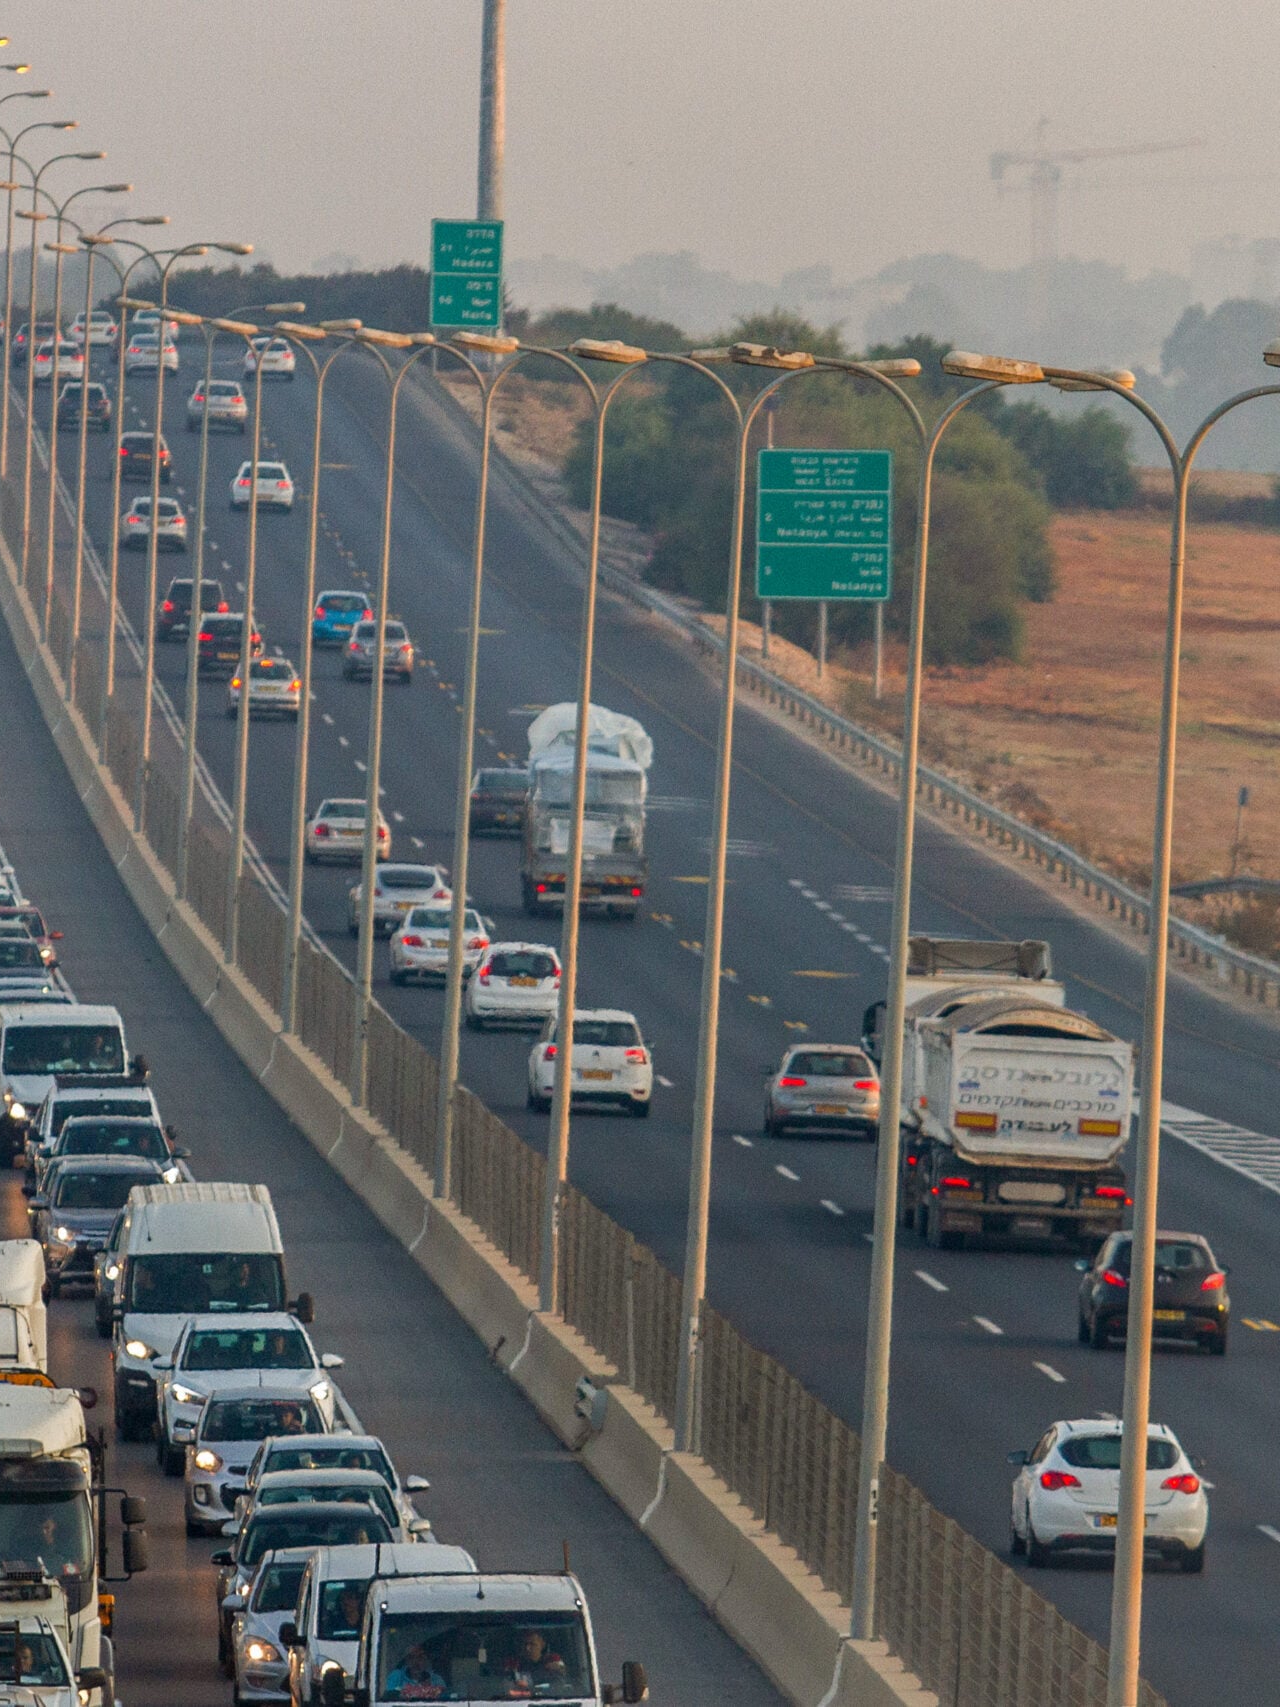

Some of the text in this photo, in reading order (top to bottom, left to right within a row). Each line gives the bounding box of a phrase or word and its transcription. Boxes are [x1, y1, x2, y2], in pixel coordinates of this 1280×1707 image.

[452, 258, 494, 268] Hadera
[777, 527, 828, 539] Netanya
[831, 581, 883, 592] Netanya
[1053, 1098, 1116, 1113] מרכבים
